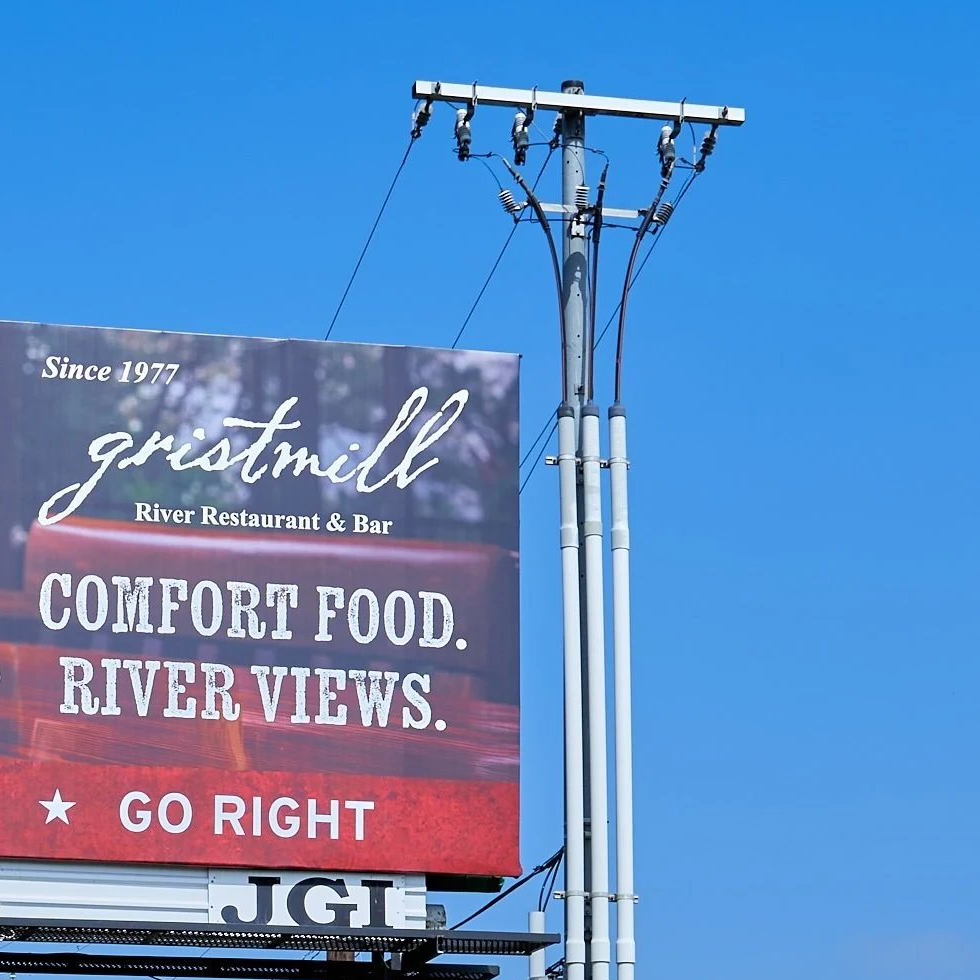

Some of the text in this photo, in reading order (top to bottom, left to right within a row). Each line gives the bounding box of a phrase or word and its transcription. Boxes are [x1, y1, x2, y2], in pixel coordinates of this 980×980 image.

[41, 355, 180, 386] Since 1977
[36, 386, 469, 526] gristmill
[134, 502, 393, 535] River Restaurant & Bar
[38, 572, 468, 651] COMFORT FOOD.
[59, 656, 447, 732] RIVER VIEWS.
[119, 790, 193, 834] GO
[214, 794, 376, 841] RIGHT
[220, 875, 394, 928] JGI
